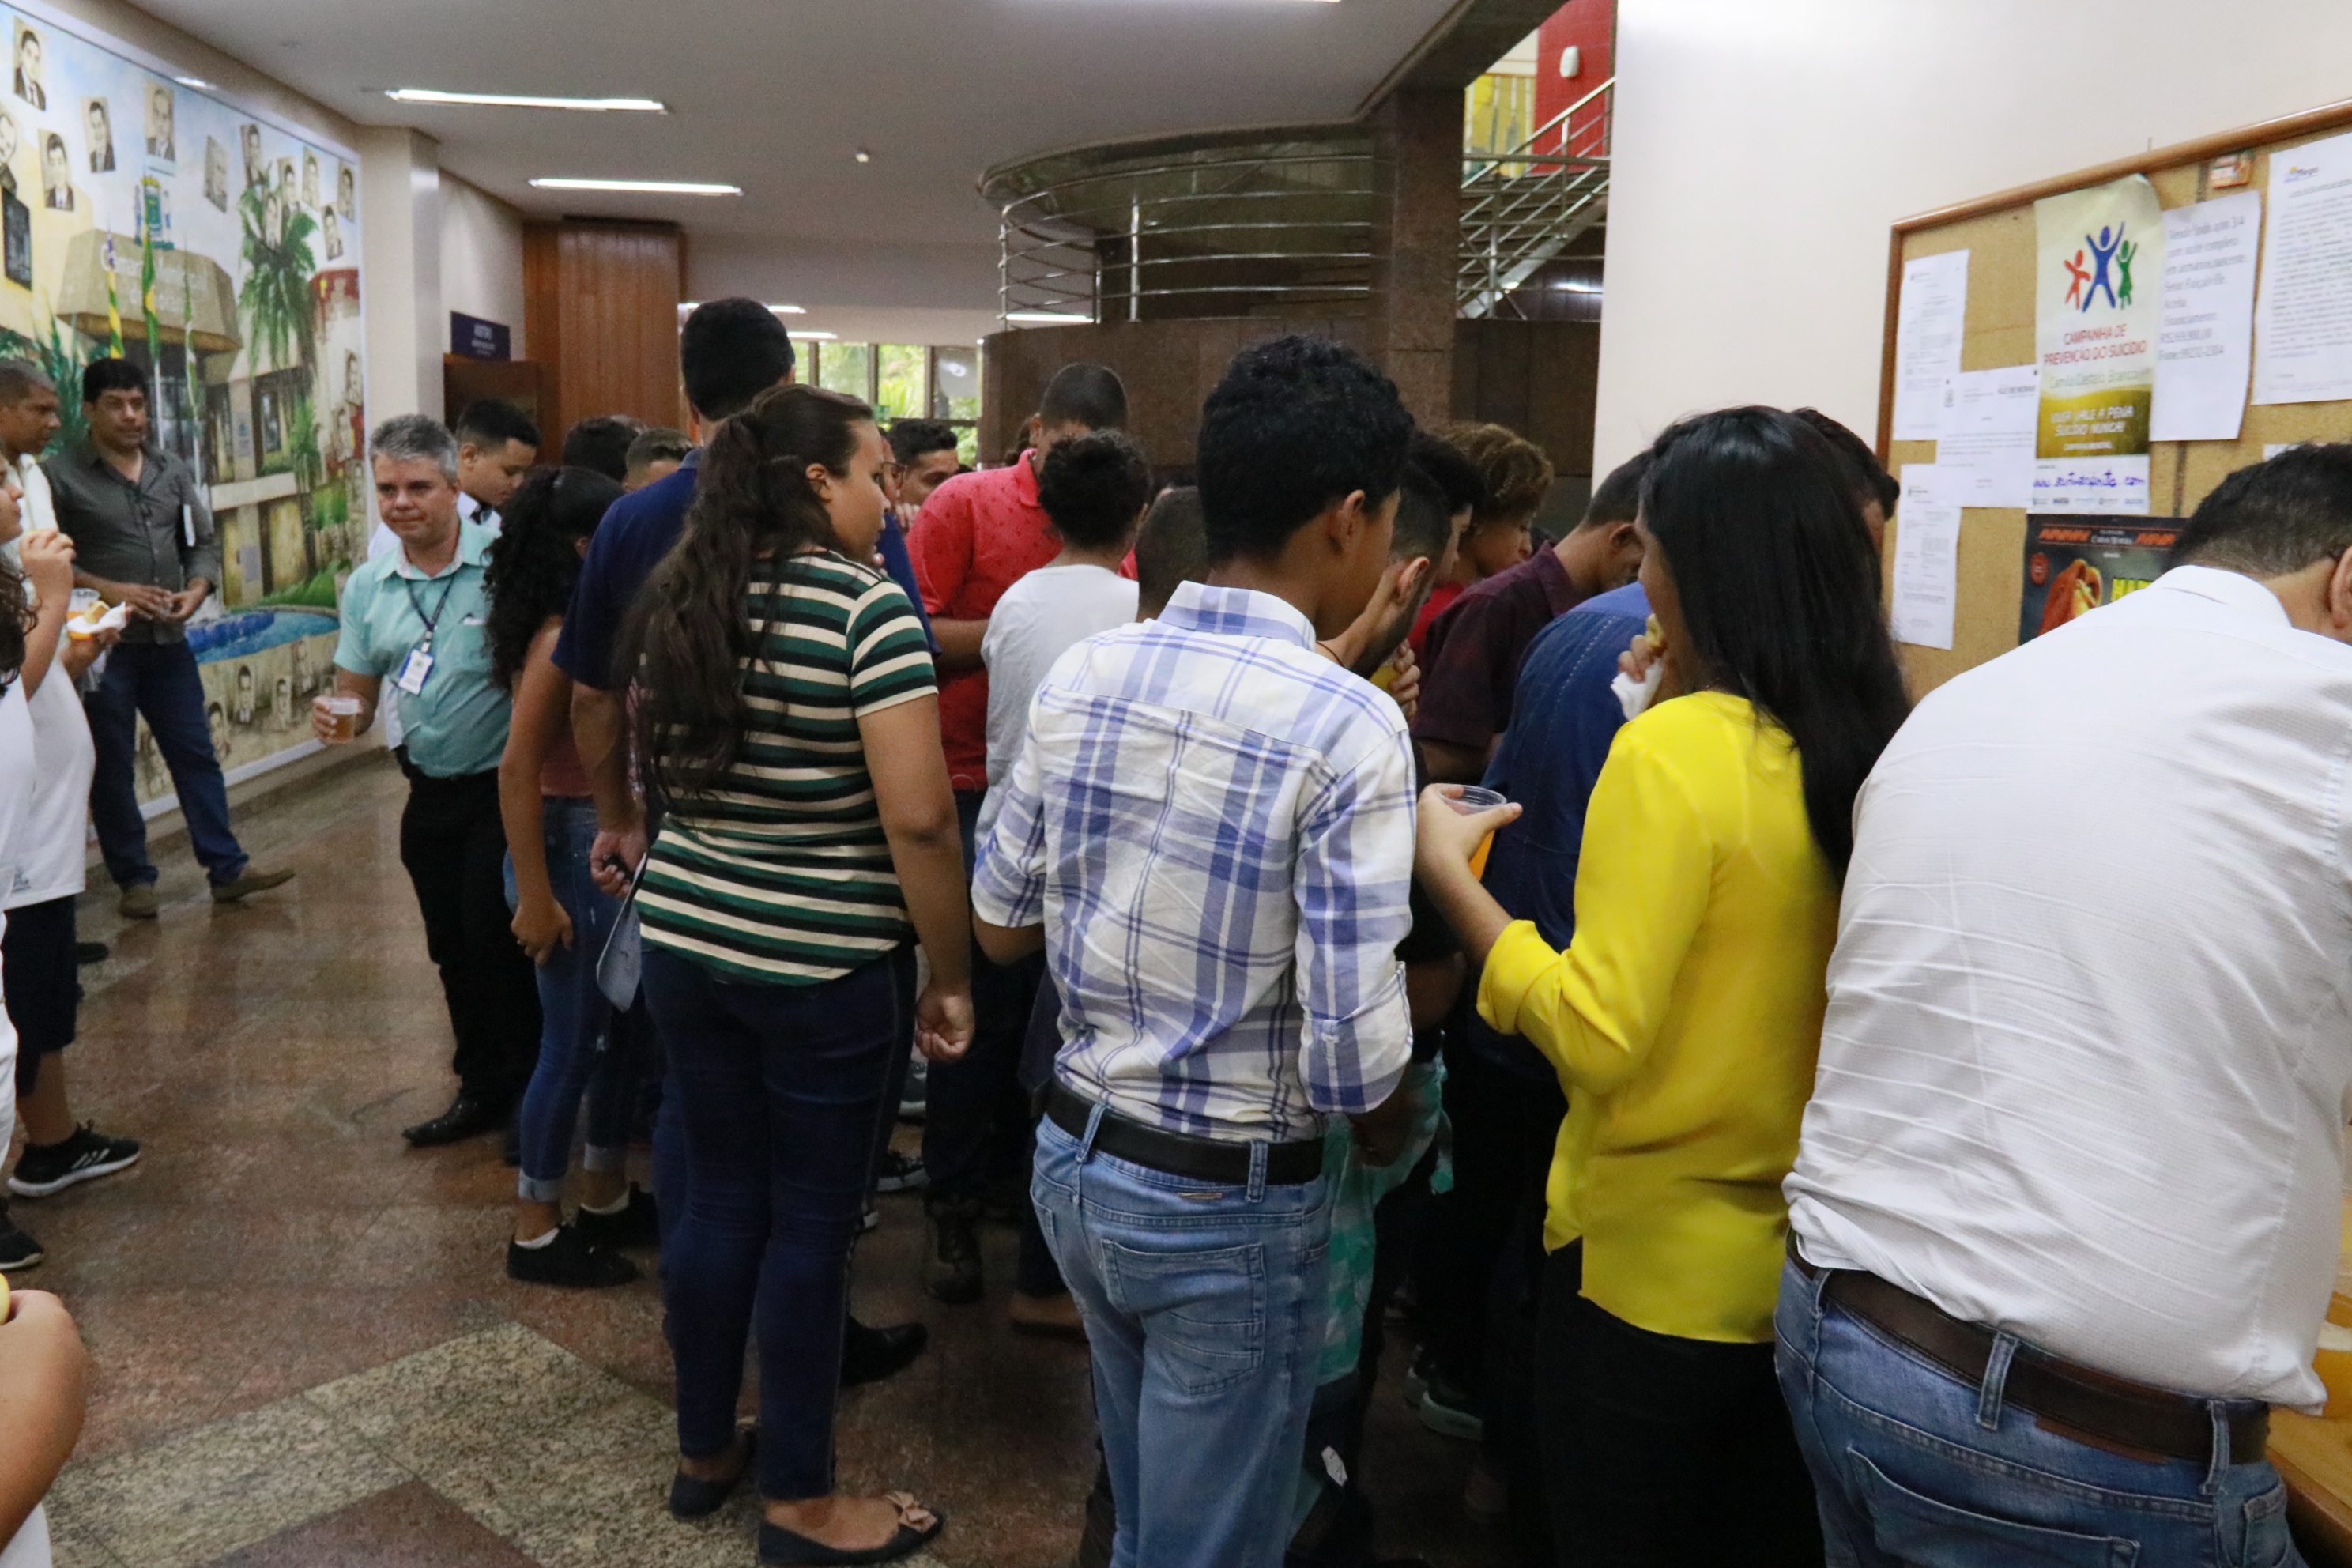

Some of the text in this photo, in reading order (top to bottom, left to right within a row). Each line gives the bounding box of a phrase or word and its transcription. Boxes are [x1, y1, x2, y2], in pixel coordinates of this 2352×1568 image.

[2064, 323, 2127, 345] CAMPANHA DE
[2093, 345, 2106, 360] DO
